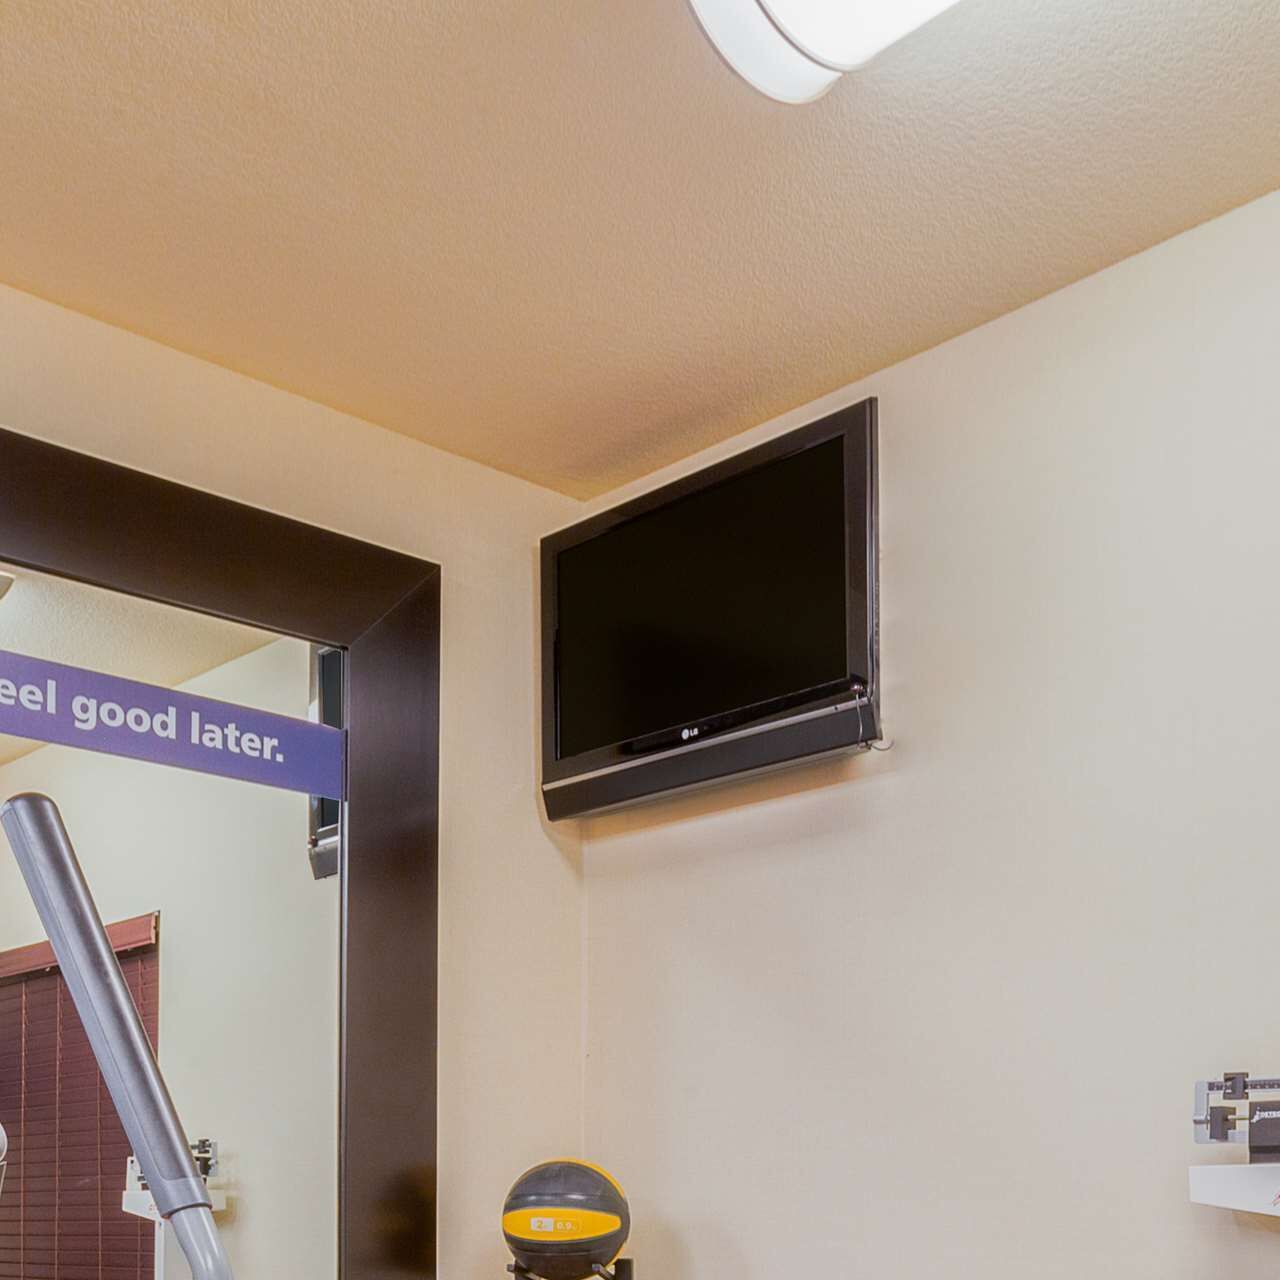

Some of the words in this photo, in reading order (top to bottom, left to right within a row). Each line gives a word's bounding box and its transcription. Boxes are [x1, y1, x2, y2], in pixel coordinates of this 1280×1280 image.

[71, 694, 177, 740] good
[190, 711, 285, 763] later.
[689, 727, 699, 737] LG
